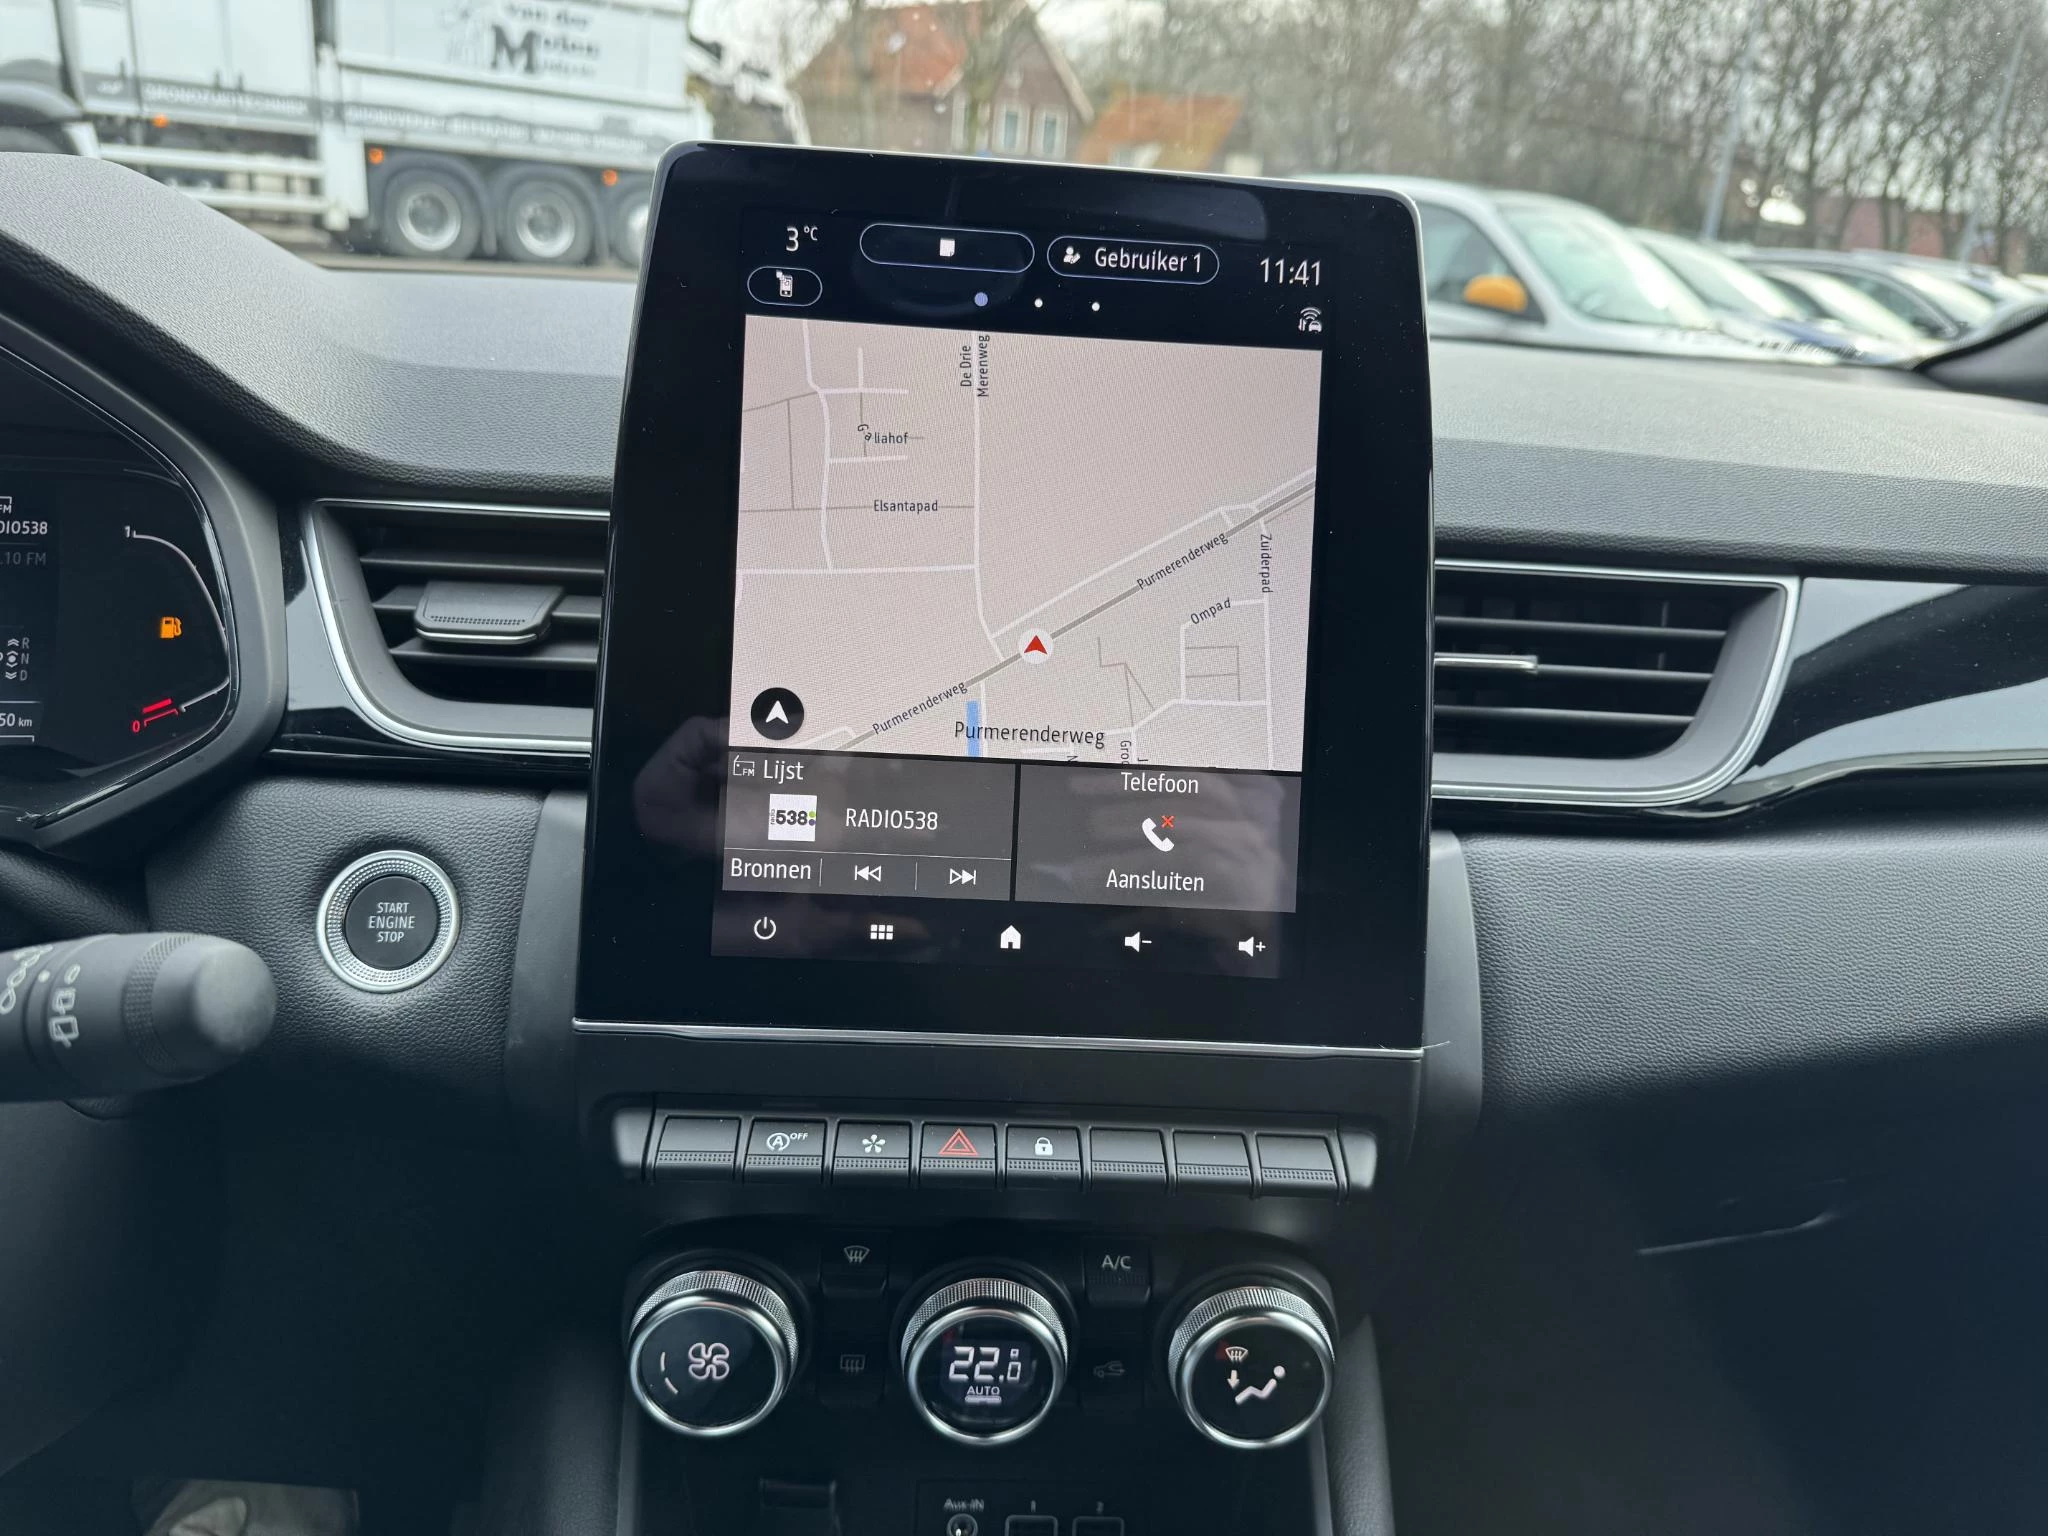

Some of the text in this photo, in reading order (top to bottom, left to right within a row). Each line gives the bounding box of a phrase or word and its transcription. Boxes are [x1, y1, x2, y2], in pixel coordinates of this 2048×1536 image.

[785, 226, 800, 252] 3
[1095, 246, 1201, 273] Gebruiker 1
[1260, 257, 1321, 286] 11:41
[959, 345, 972, 387] De Drie
[977, 334, 991, 398] Merenweg
[873, 499, 939, 515] Elsantapad
[124, 525, 131, 538] 1
[26, 551, 47, 566] FM
[1136, 532, 1229, 590] Purmerenderweg
[1258, 533, 1273, 593] Zuiderpad
[1190, 597, 1231, 625] Ompad
[22, 637, 30, 649] R
[20, 653, 30, 665] N
[20, 669, 28, 681] D
[872, 681, 968, 735] Purmerenderweg
[18, 717, 33, 727] km
[132, 720, 141, 733] 0
[955, 720, 1105, 750] Purmerenderweg
[742, 768, 755, 777] FM
[763, 759, 804, 785] Lijst
[1120, 771, 1199, 794] Telefoon
[775, 809, 808, 826] 538
[845, 808, 939, 831] RADIO538
[730, 857, 812, 880] Bronnen
[1105, 868, 1205, 892] Aansluiten
[376, 901, 410, 914] START
[367, 915, 416, 929] ENGINE
[377, 931, 405, 942] STOP
[790, 1132, 808, 1140] OFF
[1101, 1254, 1132, 1270] A/C
[966, 1385, 1001, 1395] AUTO
